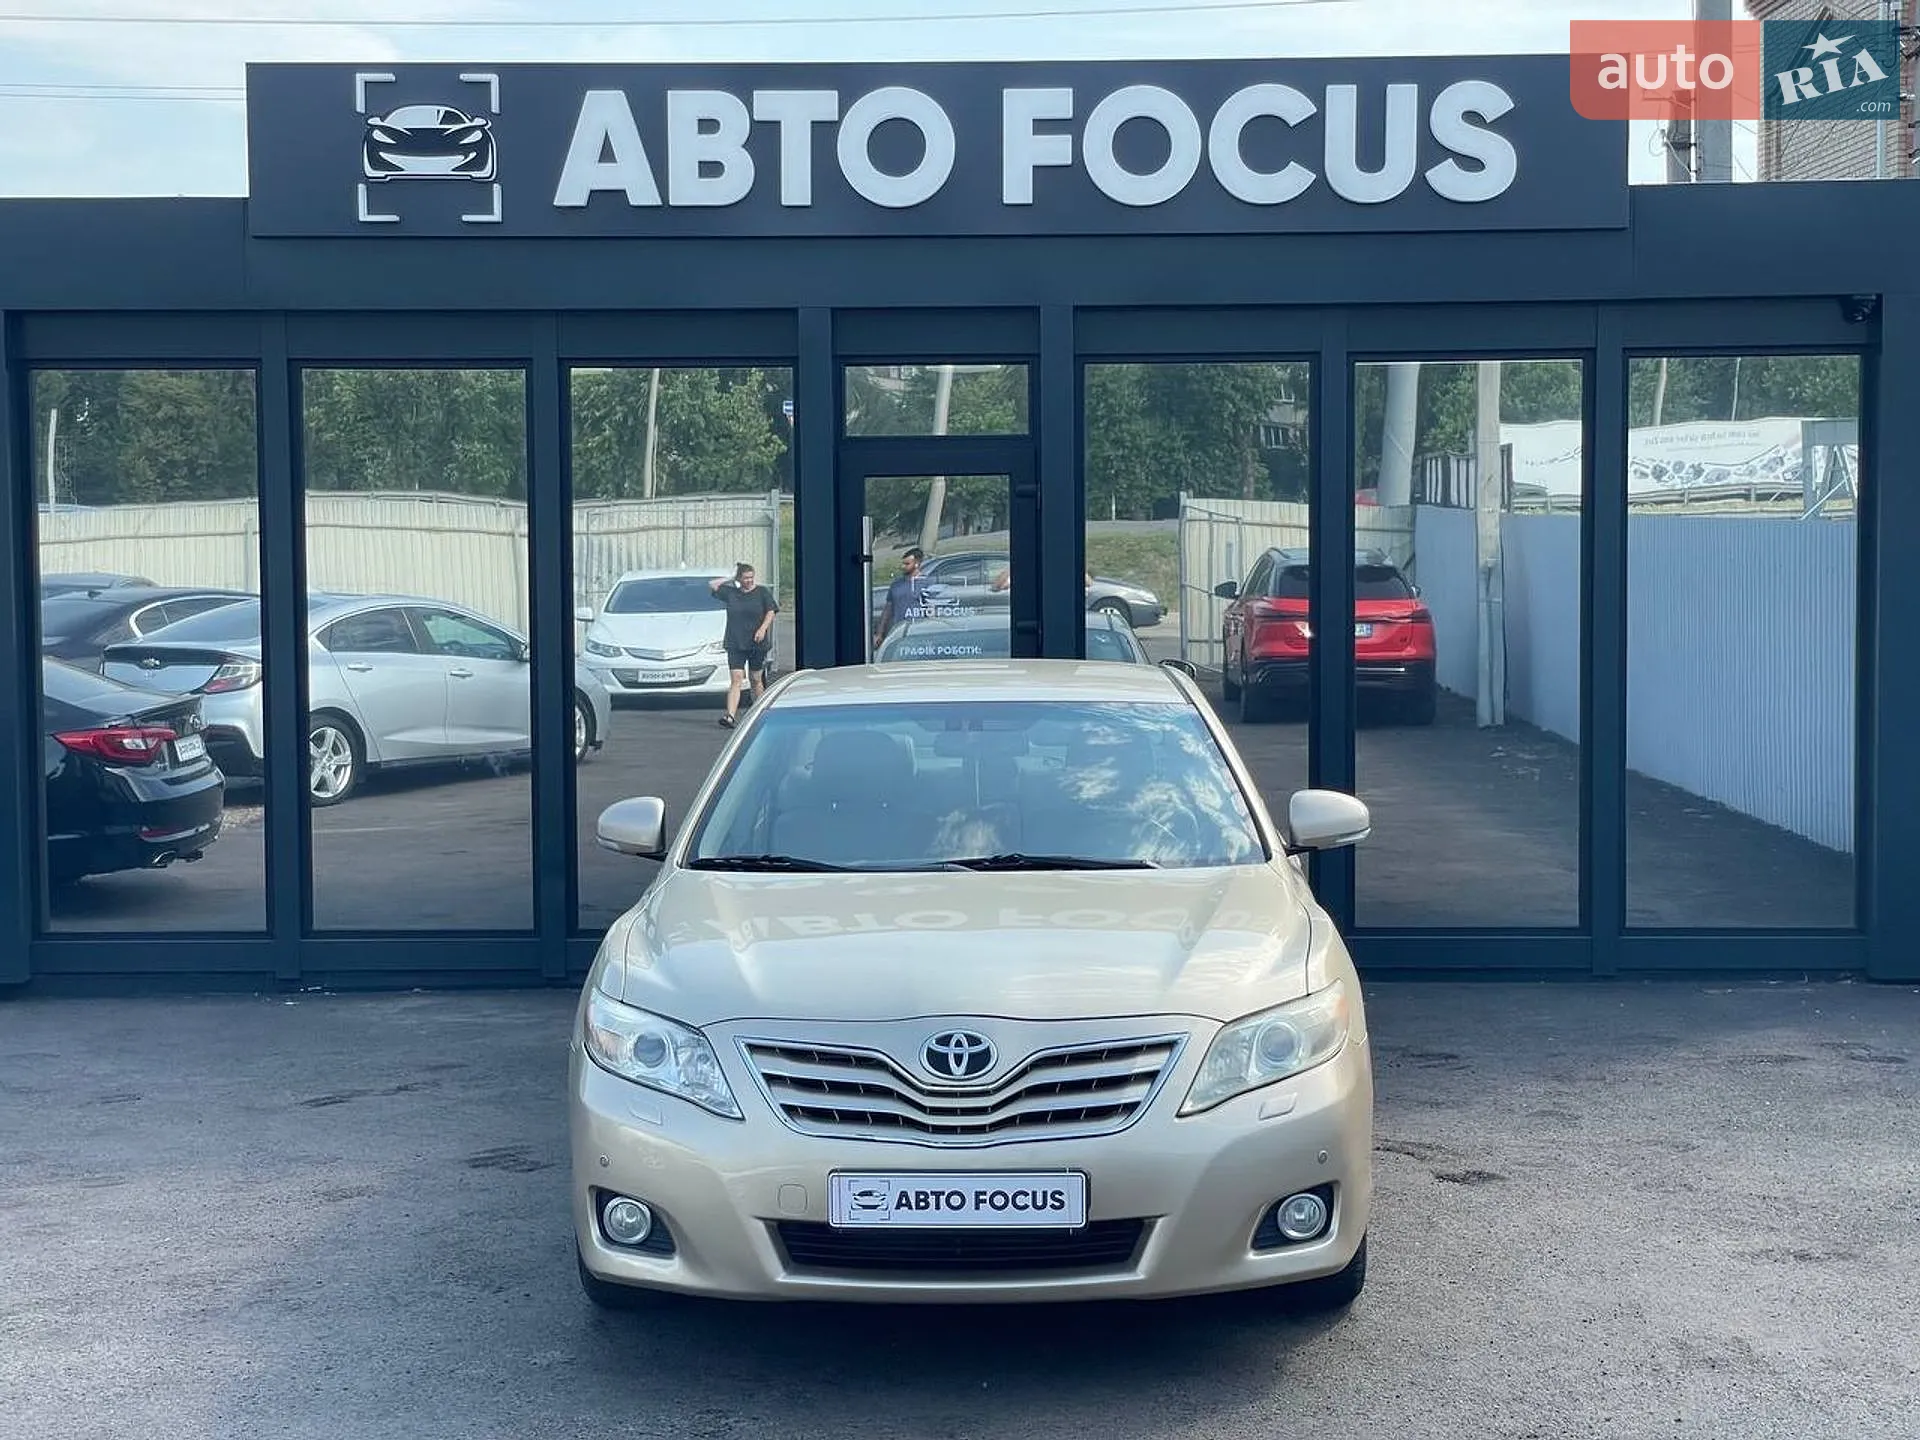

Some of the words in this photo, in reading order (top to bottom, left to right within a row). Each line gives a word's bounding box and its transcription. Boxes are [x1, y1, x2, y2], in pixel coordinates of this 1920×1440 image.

[553, 86, 956, 207] АВТО
[1002, 80, 1518, 206] FOCUS
[938, 607, 975, 617] FOCUS
[895, 1190, 967, 1211] АВТО
[974, 1190, 1066, 1211] FOCUS
